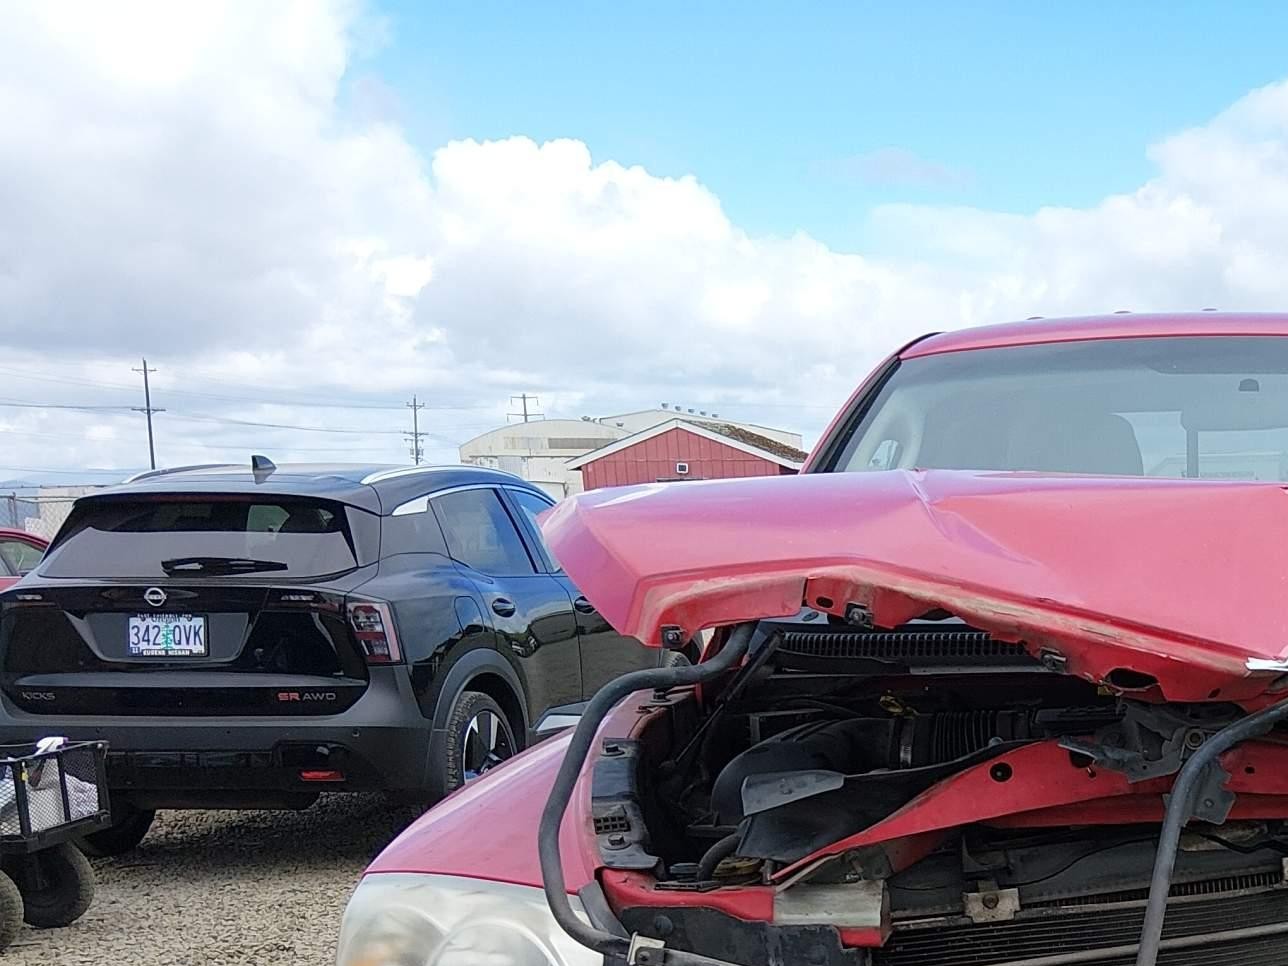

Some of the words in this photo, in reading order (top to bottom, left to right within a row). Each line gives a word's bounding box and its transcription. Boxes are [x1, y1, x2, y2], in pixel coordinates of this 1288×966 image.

[131, 624, 161, 646] 342
[172, 624, 203, 646] QVK
[22, 691, 56, 700] KICKS
[277, 692, 301, 701] SR
[302, 692, 337, 701] AWD
